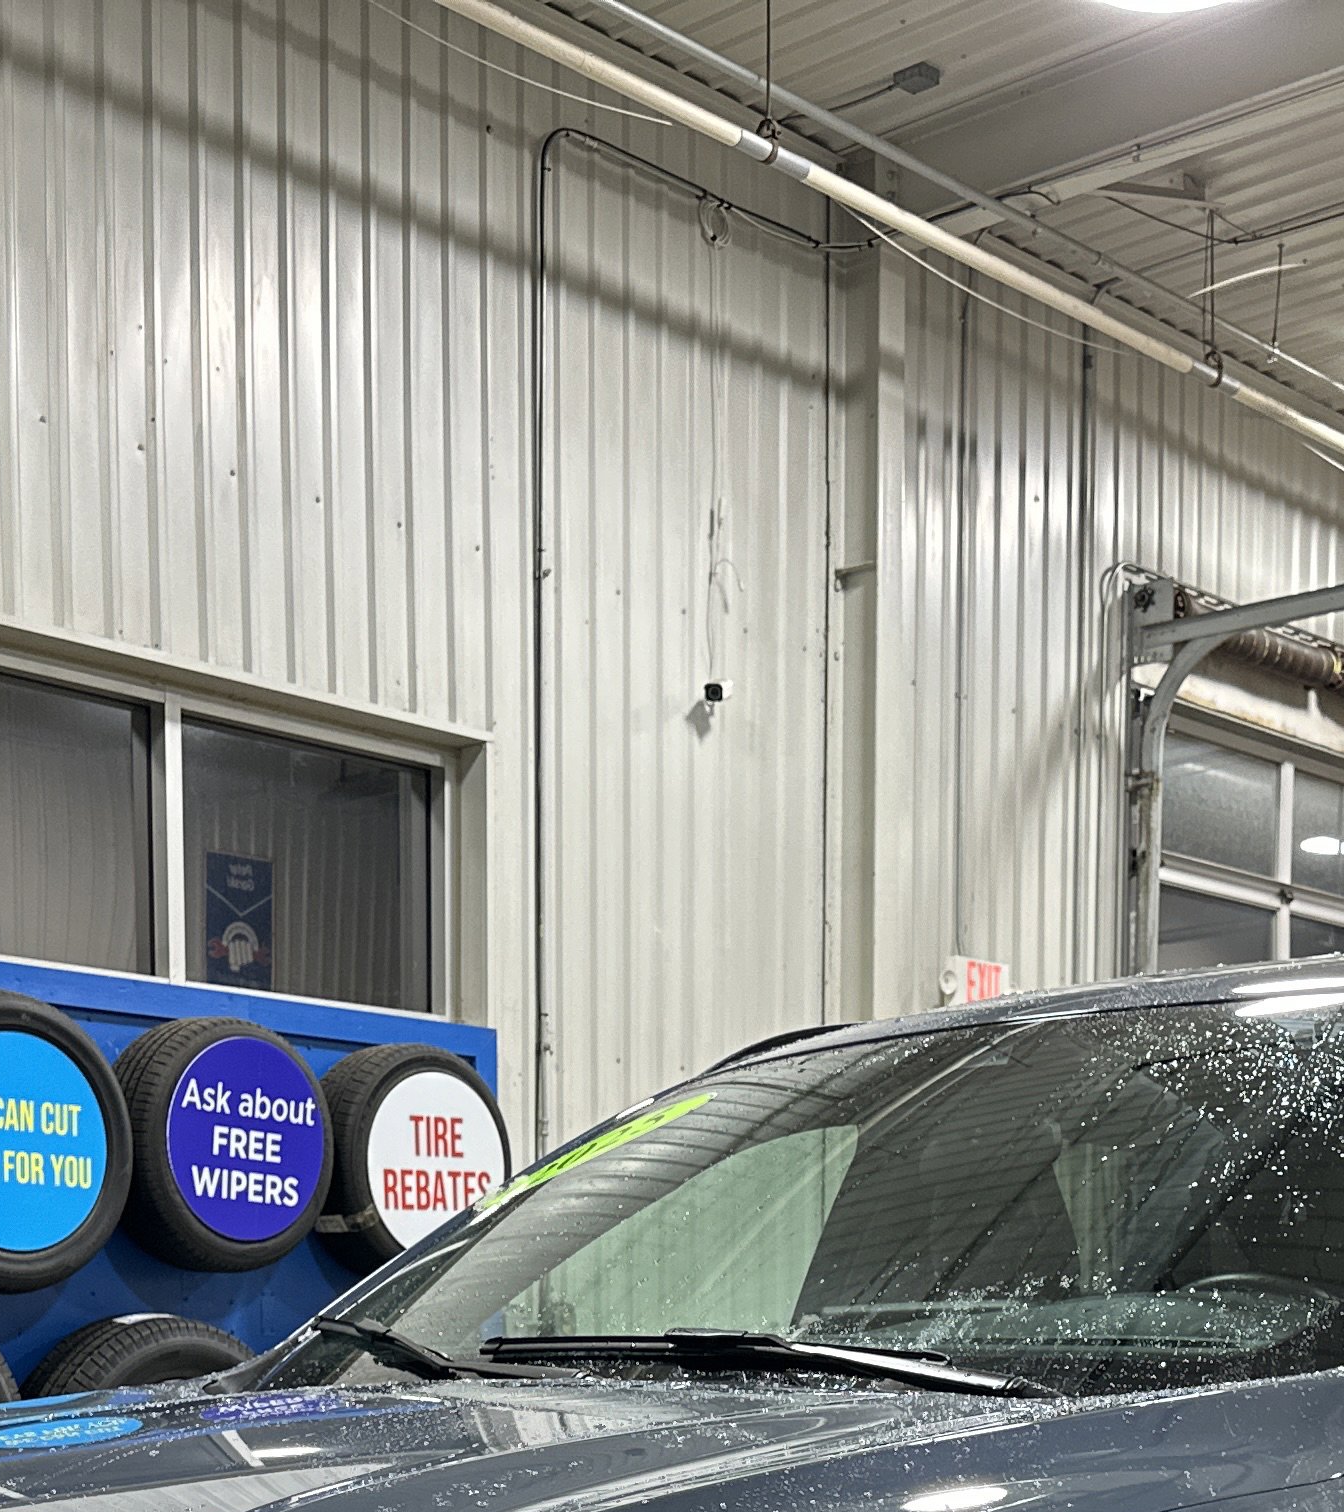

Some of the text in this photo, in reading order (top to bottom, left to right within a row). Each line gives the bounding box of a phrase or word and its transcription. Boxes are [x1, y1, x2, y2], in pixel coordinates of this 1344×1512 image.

[966, 959, 1002, 1003] EXIT
[41, 1102, 81, 1136] CUT
[182, 1078, 315, 1126] Ask about
[213, 1126, 281, 1163] FREE
[410, 1115, 463, 1158] TIRE
[4, 1150, 44, 1185] FOR
[50, 1154, 91, 1189] YOU
[192, 1165, 298, 1206] WIPERS
[384, 1169, 491, 1212] REBATES
